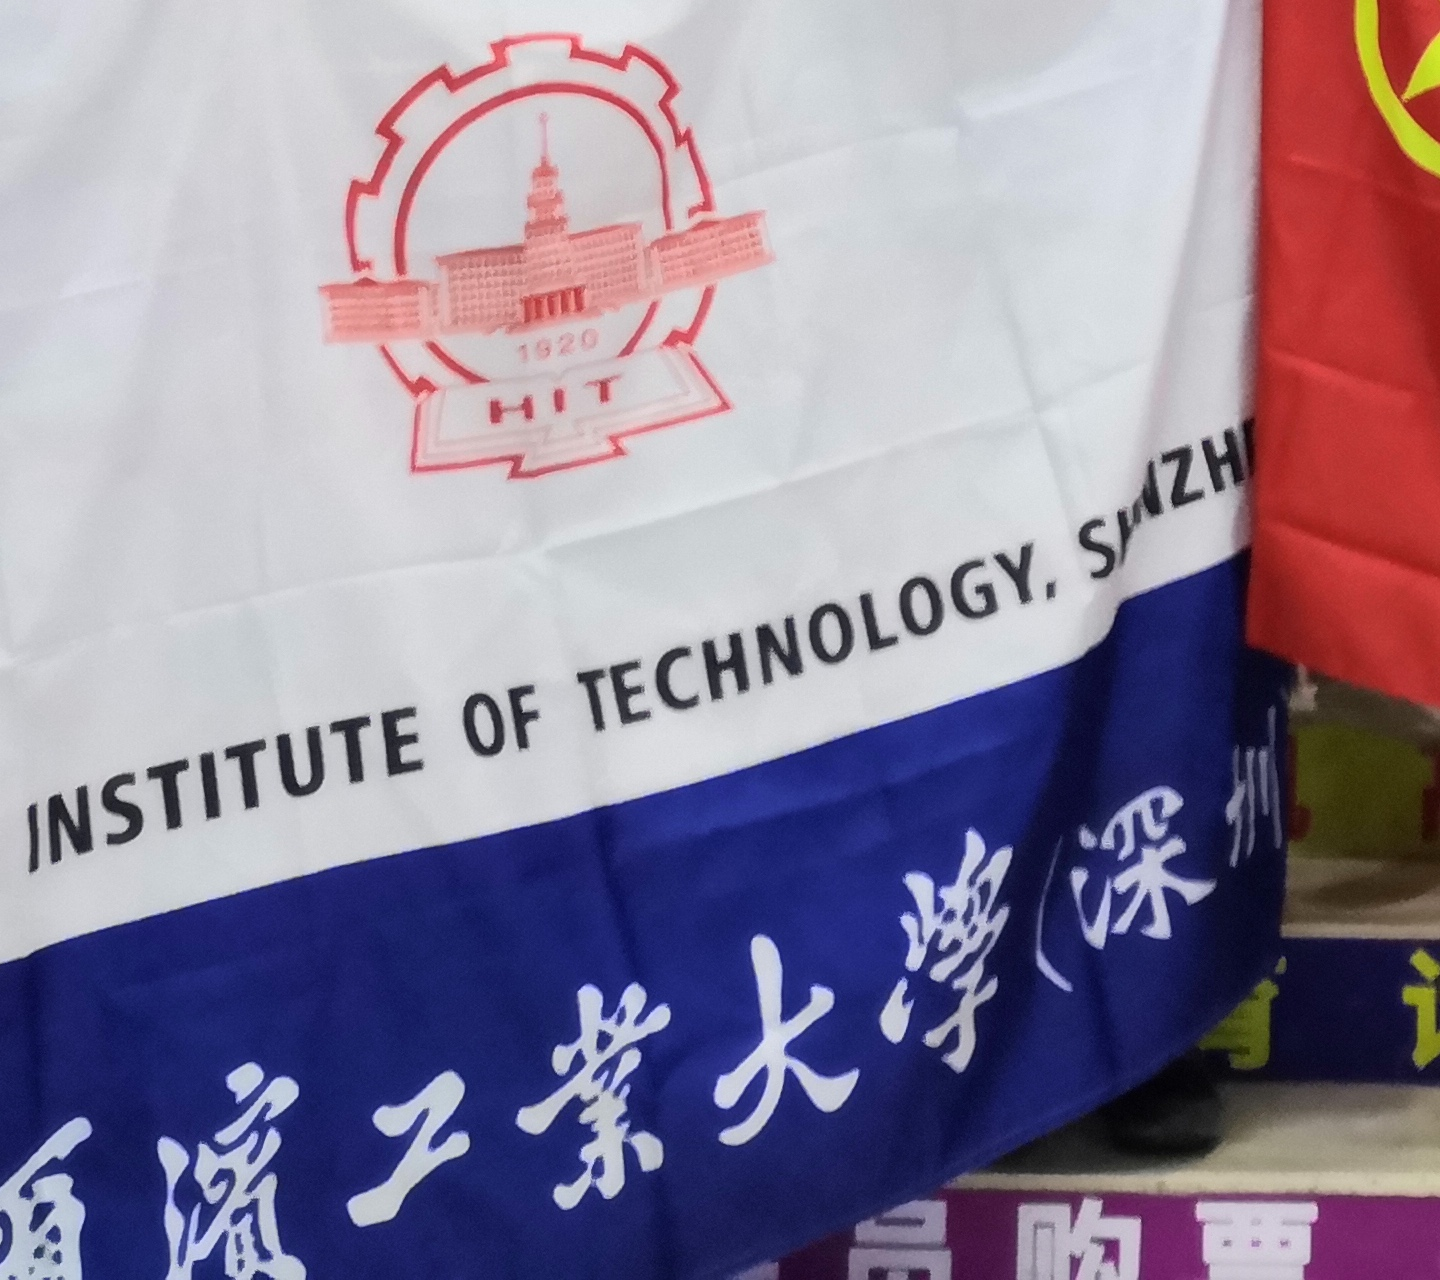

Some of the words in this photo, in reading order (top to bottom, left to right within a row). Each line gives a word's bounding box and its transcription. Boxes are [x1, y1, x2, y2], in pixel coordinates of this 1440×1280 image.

[518, 327, 600, 363] 1920
[489, 373, 622, 424] HIT
[27, 705, 425, 873] INSTITUTE
[462, 684, 541, 758] OF
